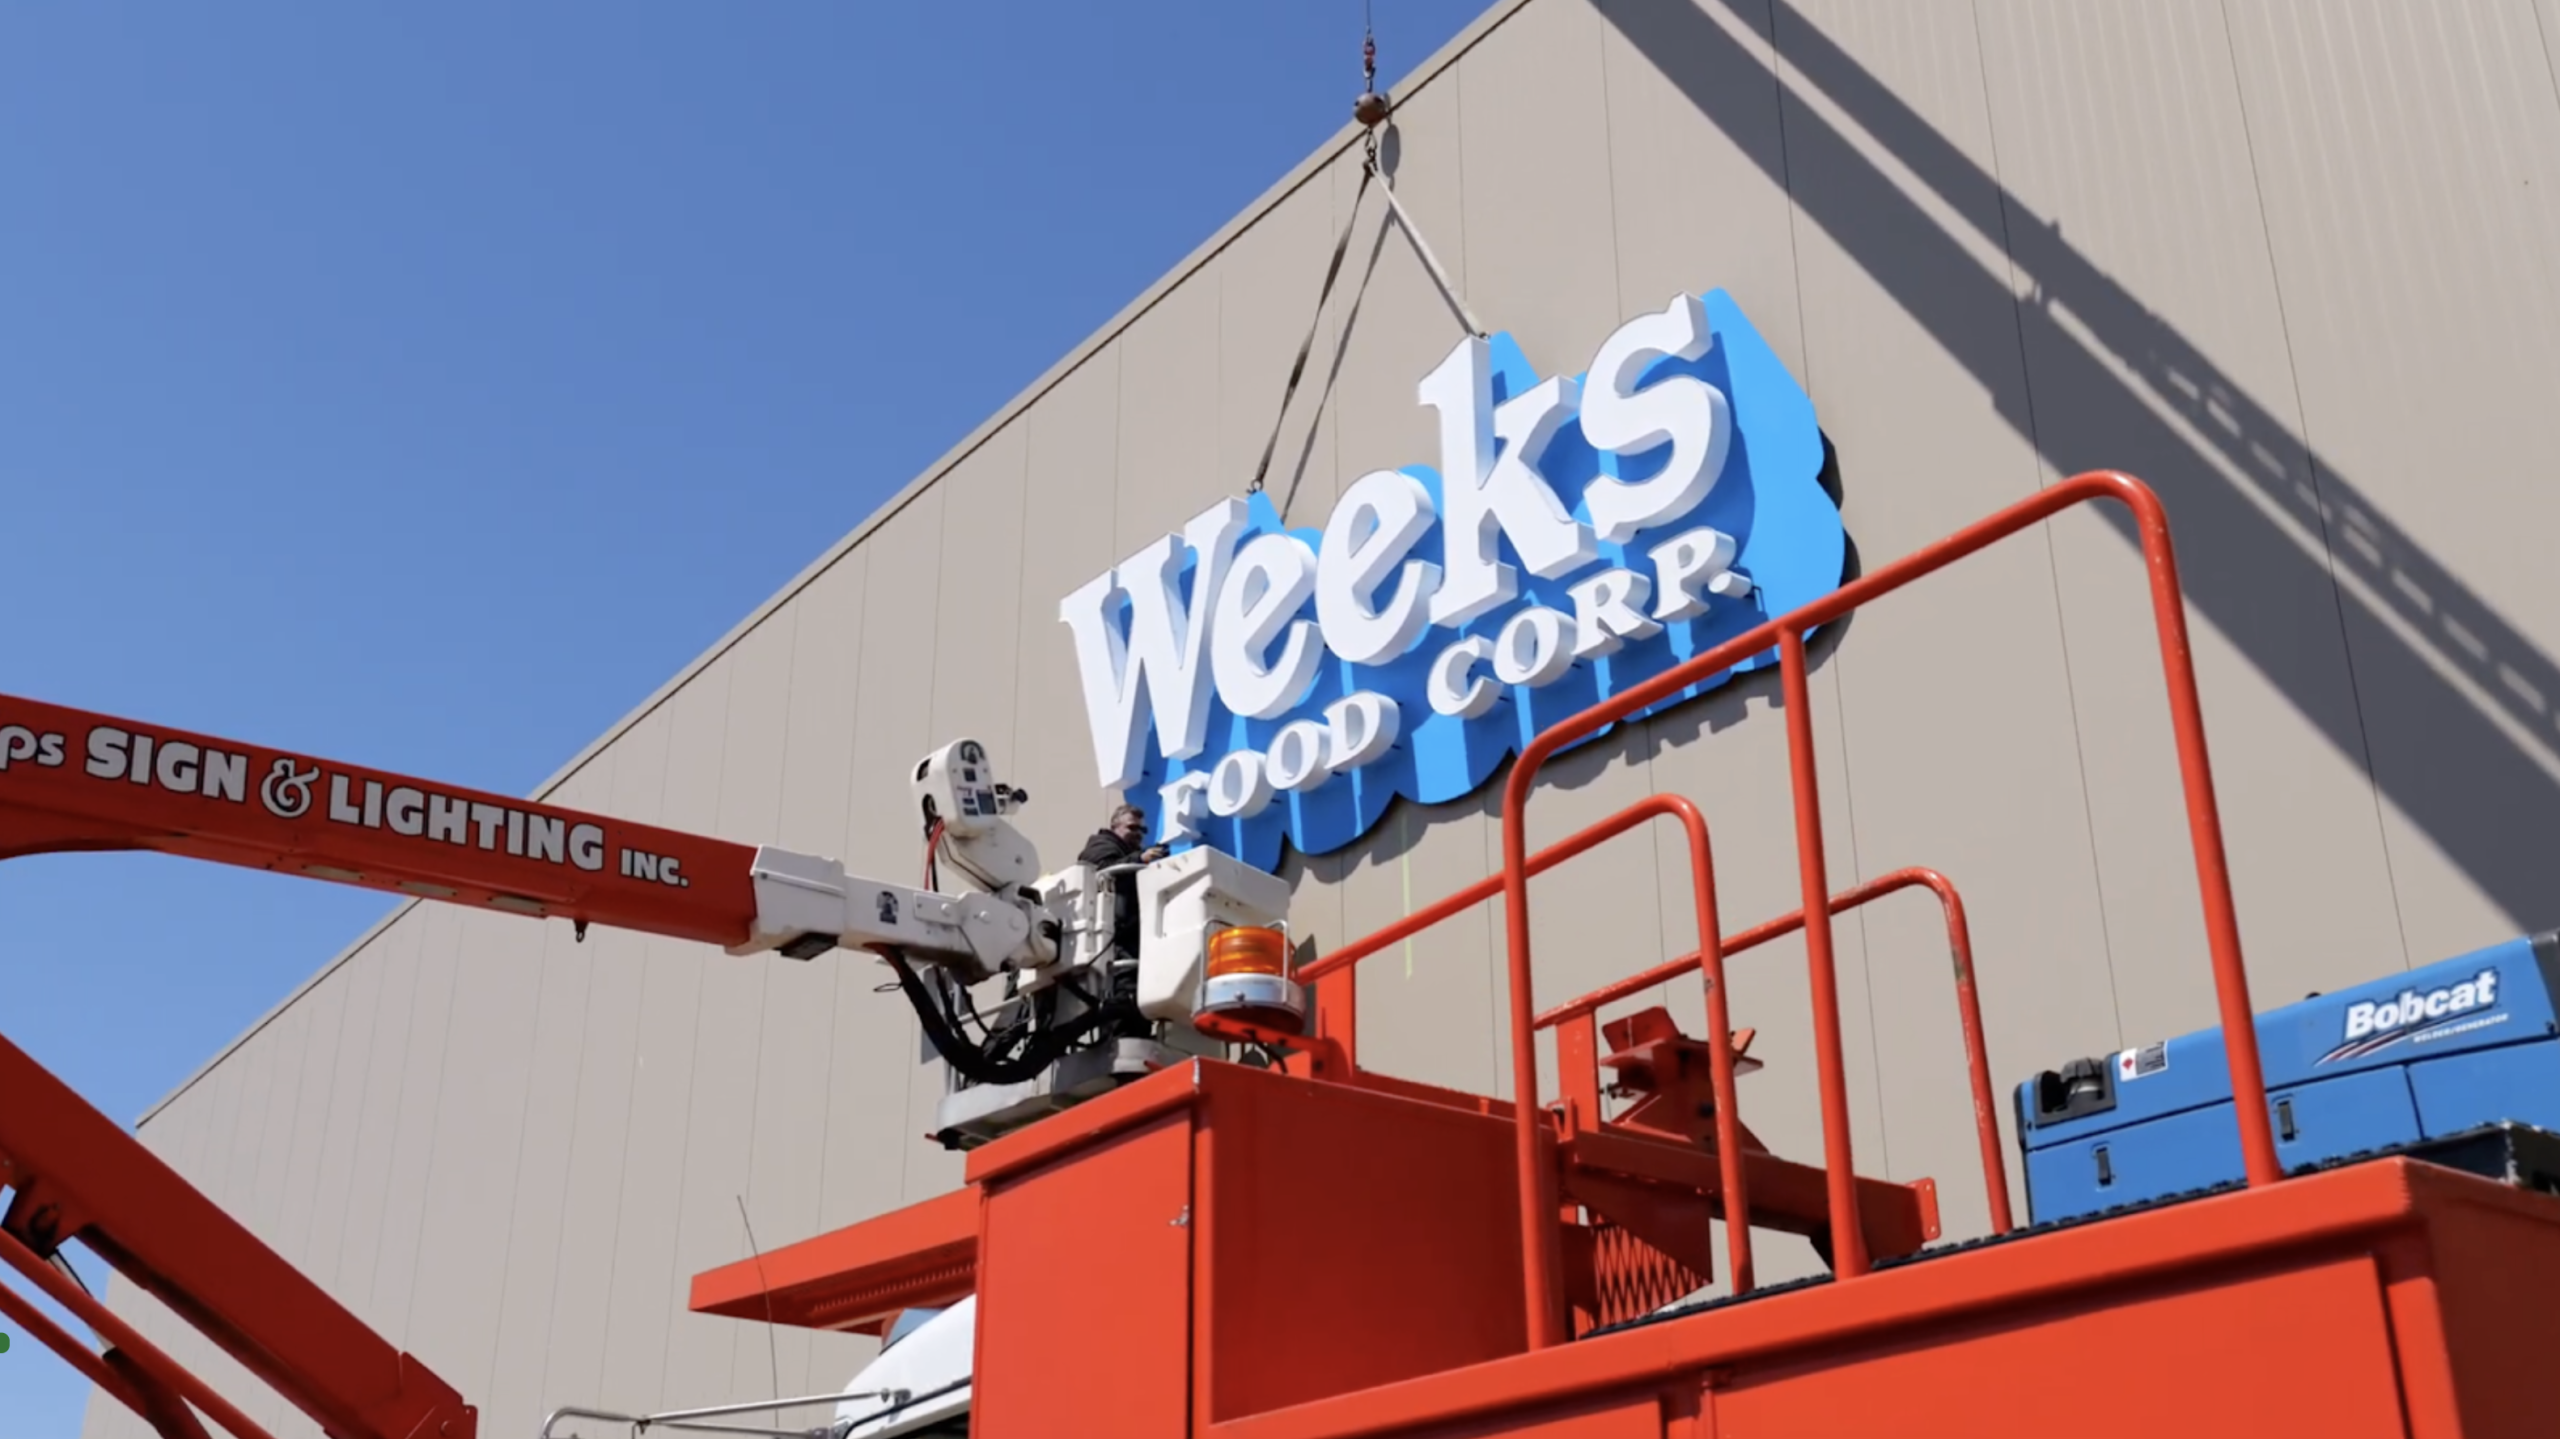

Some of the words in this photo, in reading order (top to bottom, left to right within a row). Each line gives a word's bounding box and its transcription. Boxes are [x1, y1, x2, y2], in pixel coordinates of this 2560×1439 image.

[1058, 290, 1731, 792] Weeks
[1157, 689, 1401, 846] FOOD
[1426, 525, 1753, 720] CORP.
[84, 726, 248, 802] SIGN
[260, 757, 320, 819] &
[327, 773, 606, 872] LIGHTING
[620, 848, 690, 888] INC.
[2345, 969, 2496, 1039] Bobcat
